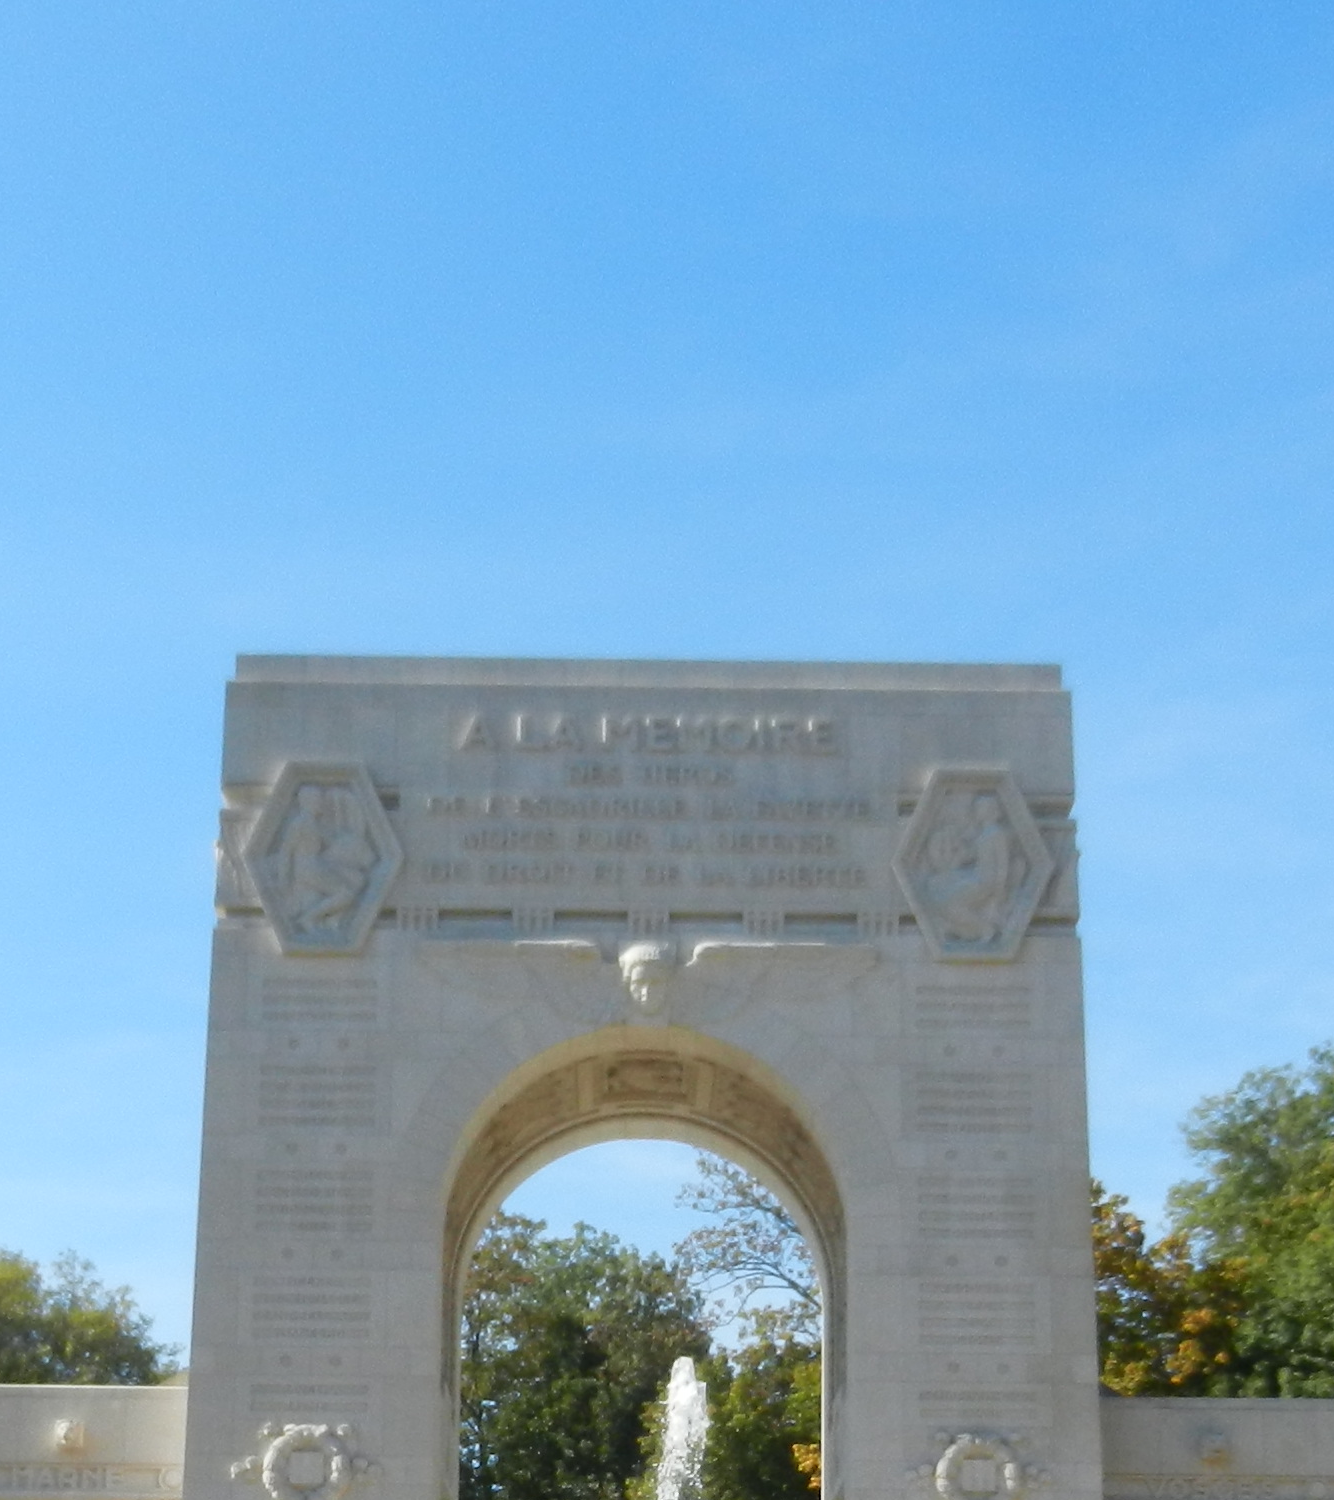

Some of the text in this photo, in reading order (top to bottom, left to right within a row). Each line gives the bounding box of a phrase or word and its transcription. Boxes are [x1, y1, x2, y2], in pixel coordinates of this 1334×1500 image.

[454, 713, 844, 757] A LA MEMOIRE
[12, 1465, 124, 1490] MARNE
[1142, 1477, 1275, 1500] VOSGES
